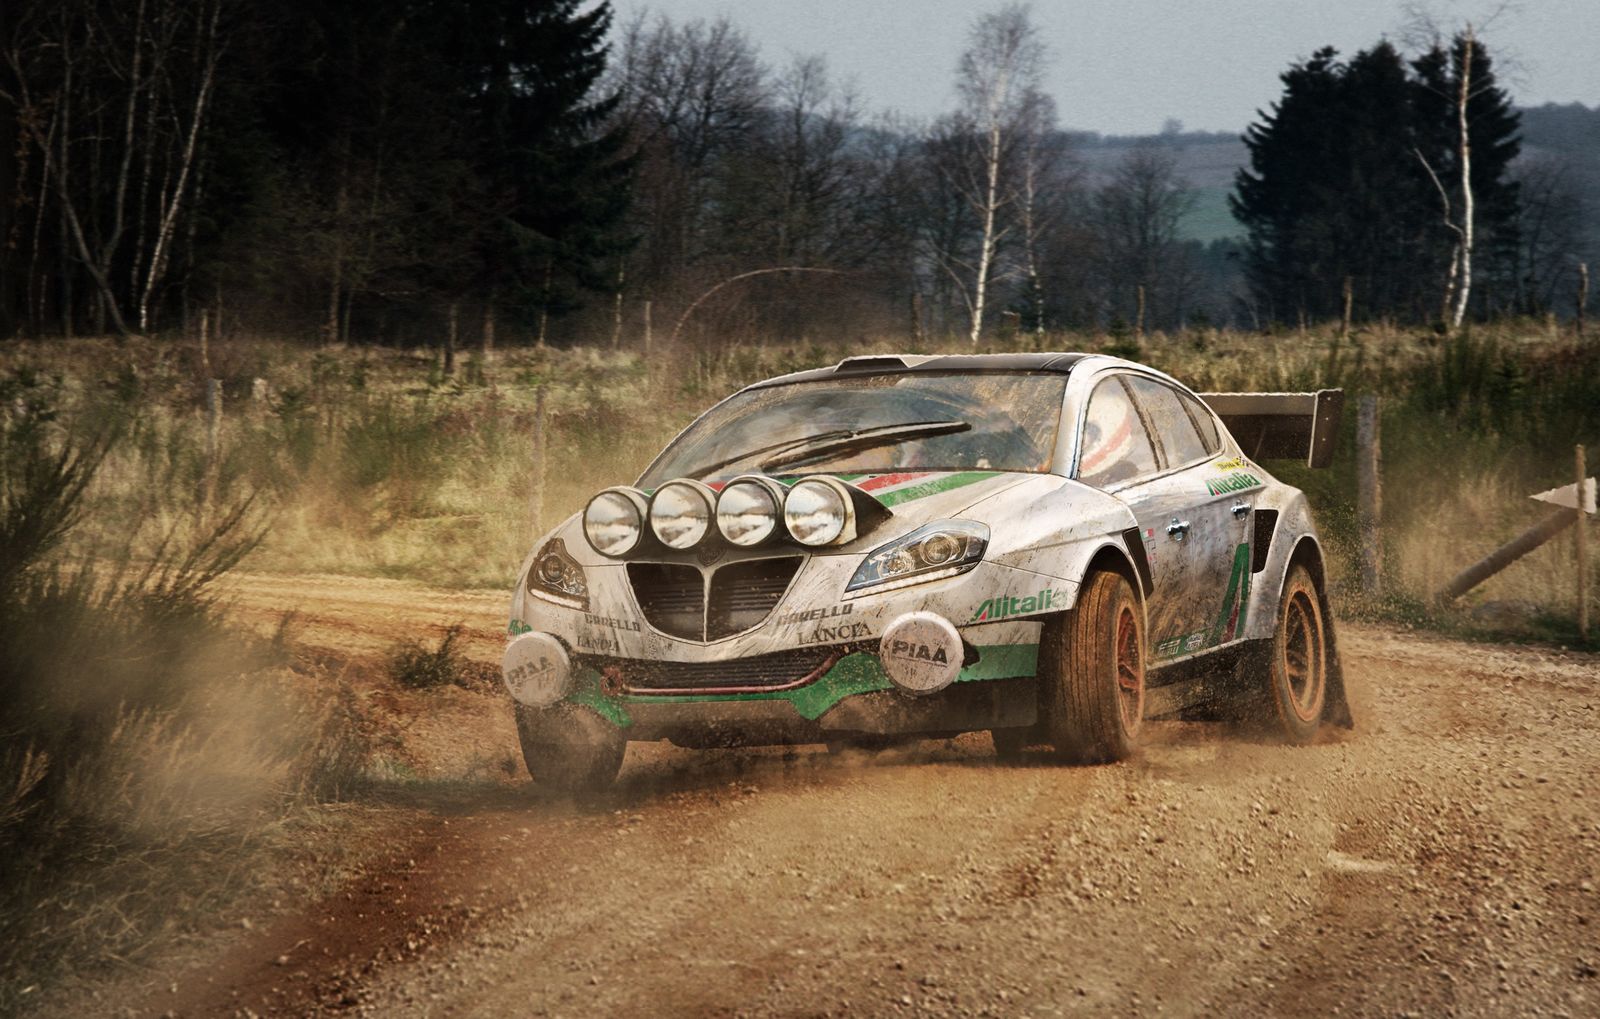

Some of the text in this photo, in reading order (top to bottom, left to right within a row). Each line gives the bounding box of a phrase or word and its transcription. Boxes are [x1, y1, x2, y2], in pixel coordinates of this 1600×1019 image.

[1206, 472, 1261, 496] Alitalia
[970, 588, 1068, 622] Alitalia
[798, 621, 873, 646] LANCIA
[892, 639, 948, 664] PIAA
